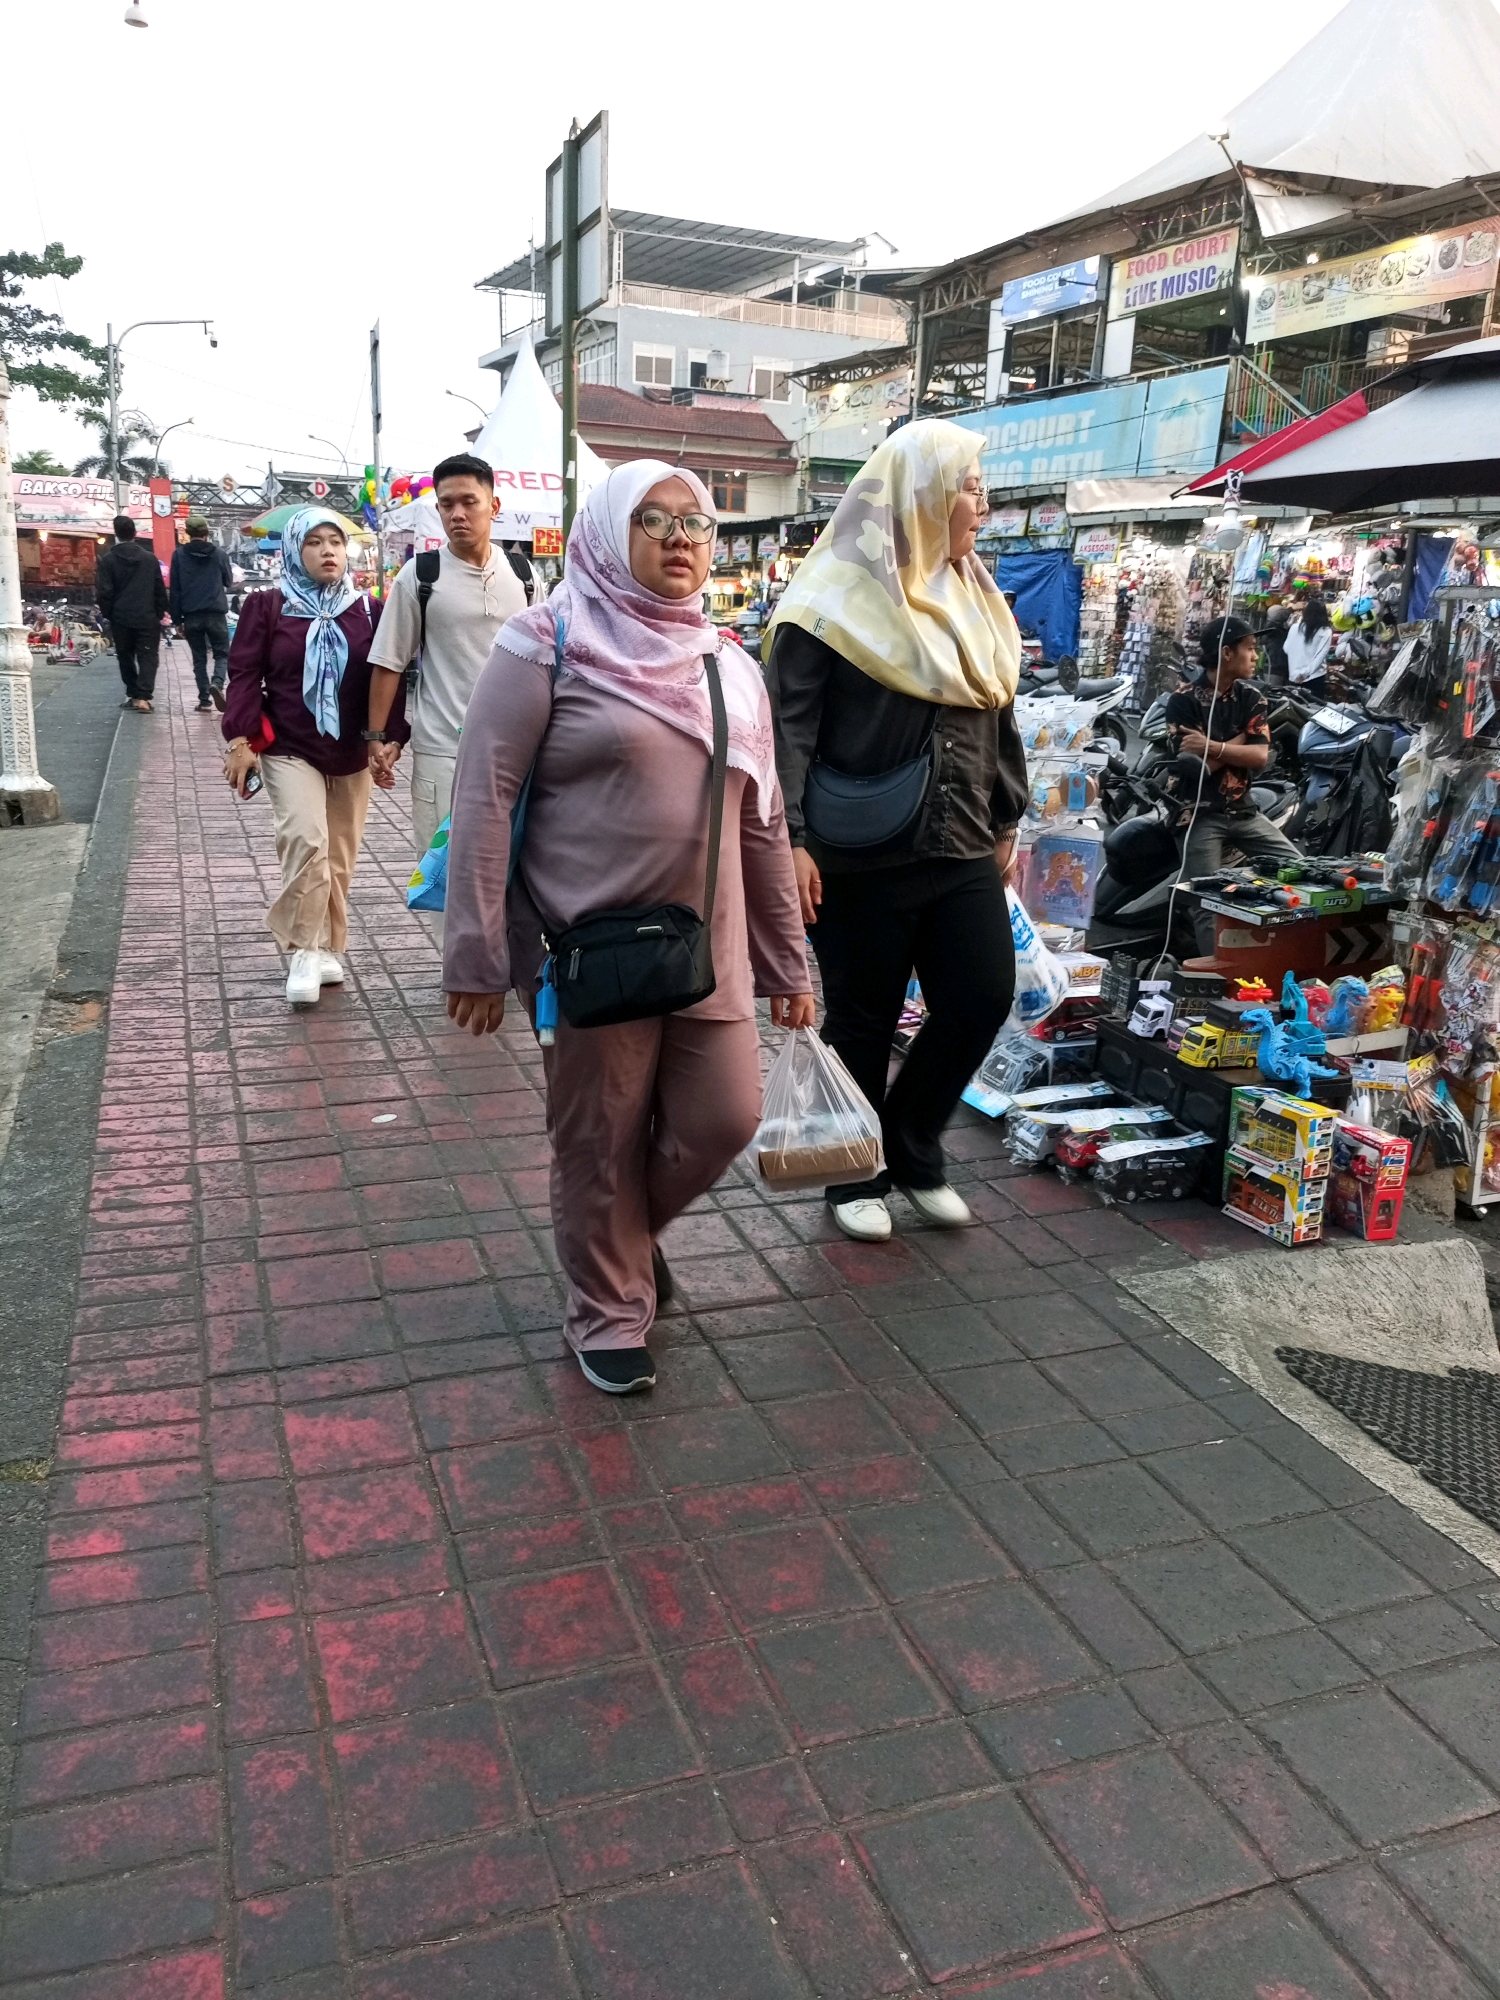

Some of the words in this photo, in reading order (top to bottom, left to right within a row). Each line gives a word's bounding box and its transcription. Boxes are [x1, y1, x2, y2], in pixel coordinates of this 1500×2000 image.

[1126, 251, 1169, 279] FOOD
[1172, 233, 1231, 266] COURT
[1022, 276, 1046, 290] FOOD
[1046, 267, 1077, 282] COURT
[1160, 265, 1217, 300] MUSIC
[972, 409, 1096, 457] DCOURT
[19, 479, 83, 498] BAKSO
[222, 477, 234, 492] S
[315, 482, 326, 495] D
[427, 541, 439, 551] 16
[1072, 966, 1101, 979] MBG
